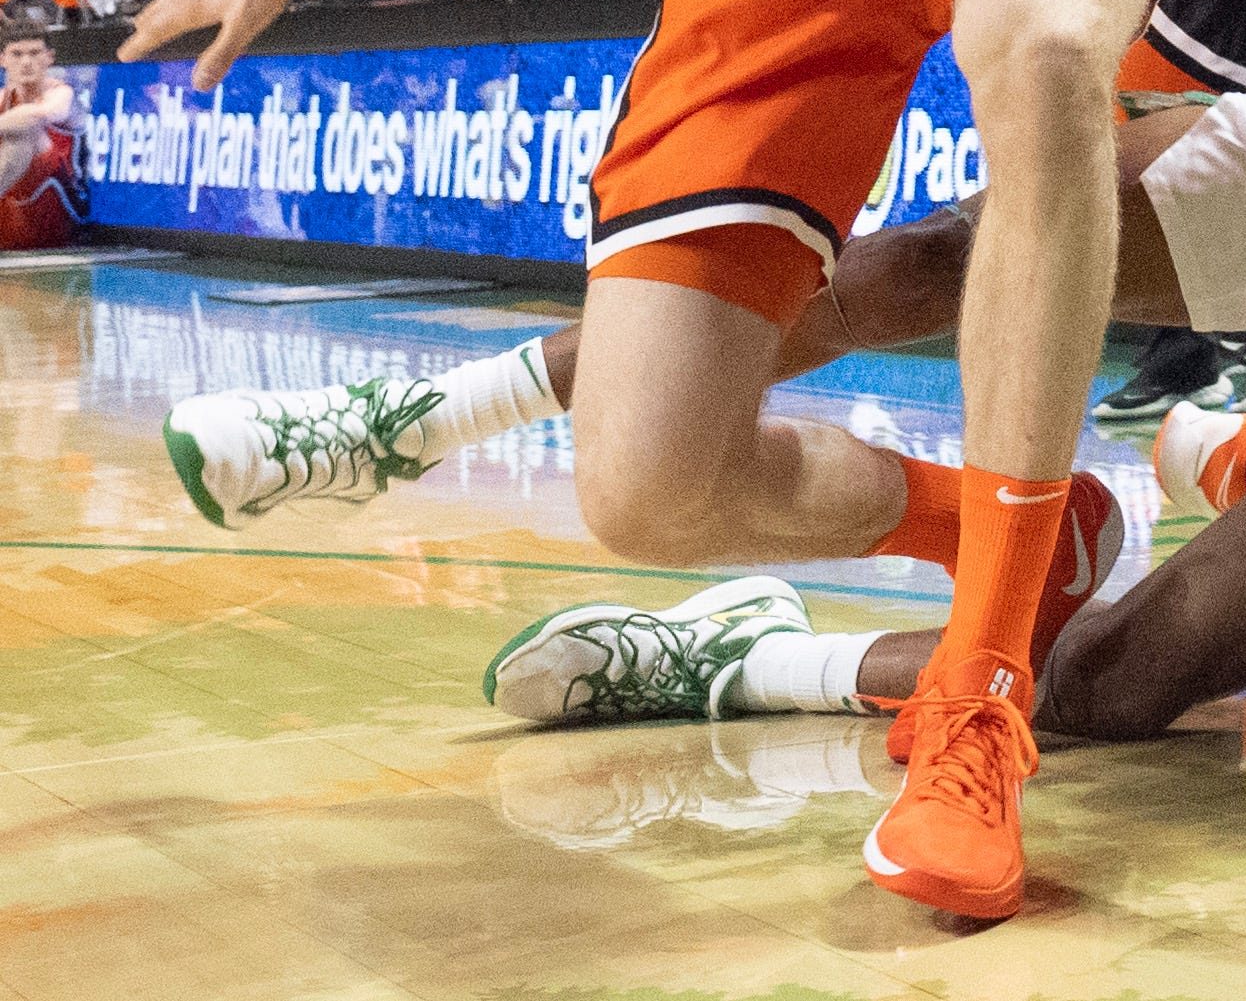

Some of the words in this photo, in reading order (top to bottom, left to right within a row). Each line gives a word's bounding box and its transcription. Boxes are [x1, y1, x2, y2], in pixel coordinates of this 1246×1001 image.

[110, 83, 189, 185] health
[188, 83, 255, 213] plan
[258, 82, 322, 193] that
[322, 81, 408, 195] does
[413, 73, 534, 202] what's
